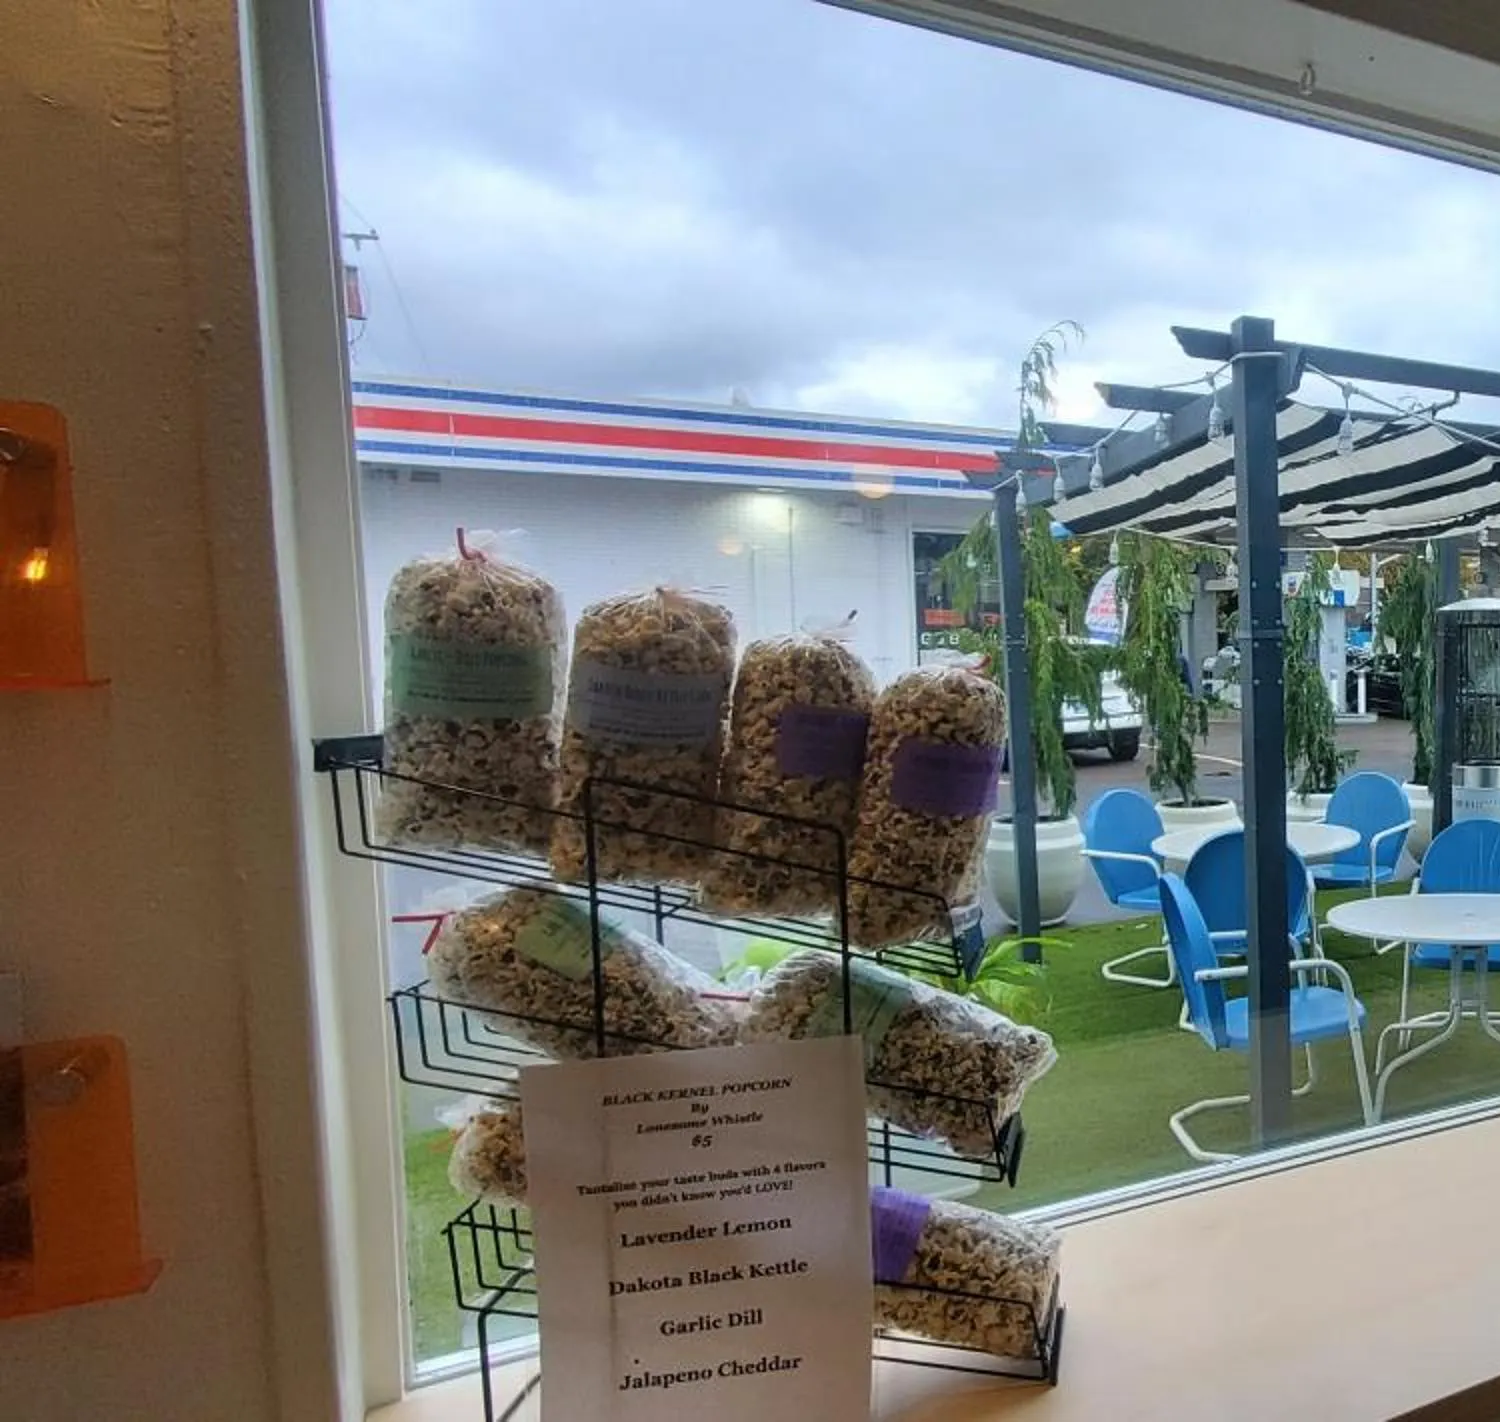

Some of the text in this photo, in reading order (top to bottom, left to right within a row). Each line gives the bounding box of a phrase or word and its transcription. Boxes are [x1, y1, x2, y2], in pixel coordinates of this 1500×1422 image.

[602, 1077, 793, 1106] BLACK KERNEL POPCORN
[637, 1112, 763, 1134] Lonesome Whistle
[691, 1102, 709, 1114] By
[691, 1134, 712, 1148] $5
[640, 1178, 670, 1192] your
[673, 1174, 705, 1185] taste
[707, 1170, 739, 1182] buds
[741, 1166, 770, 1178] with
[783, 1159, 826, 1173] flavors
[613, 1180, 793, 1212] you didn't know you'd LOVE!
[621, 1217, 792, 1248] Lavender Lemon
[608, 1259, 809, 1297] Dakota Black Kettle
[659, 1308, 763, 1337] Garlic Dill
[619, 1355, 802, 1391] Jalapeno Cheddar
